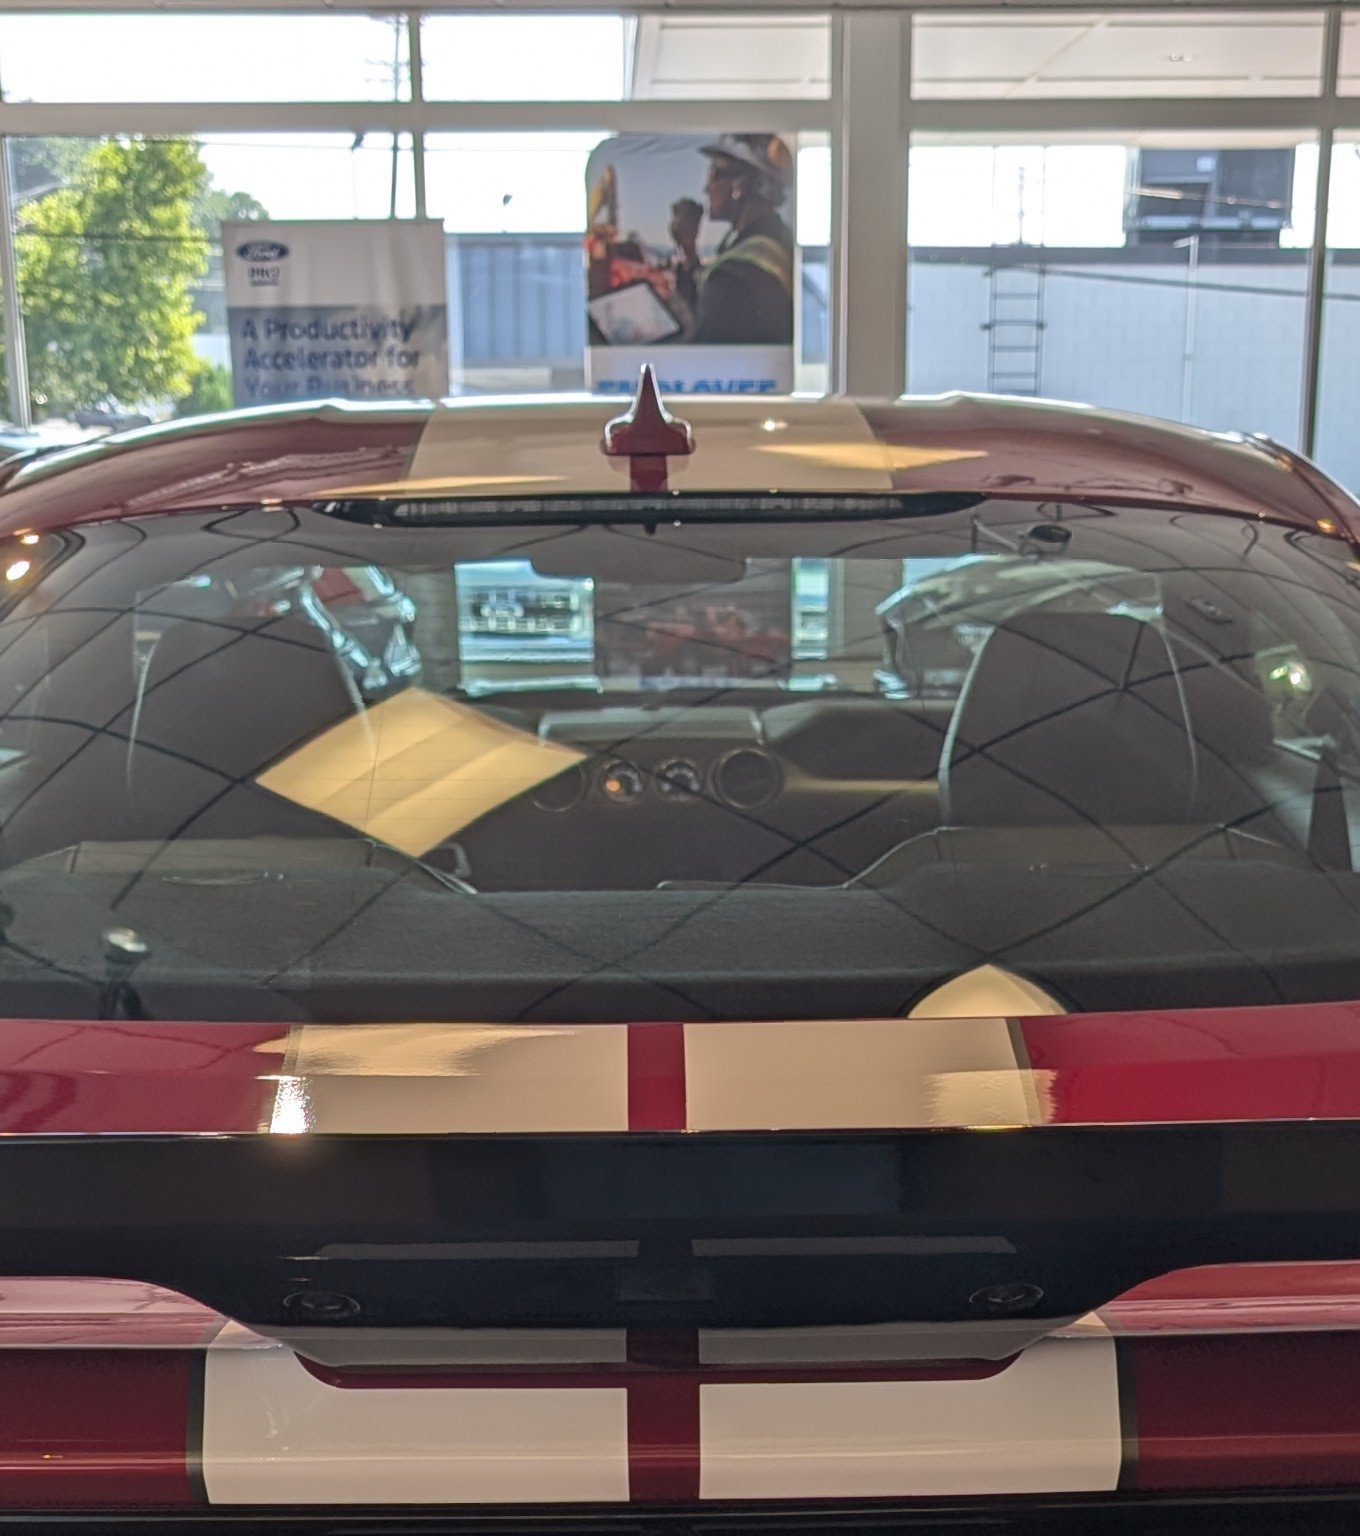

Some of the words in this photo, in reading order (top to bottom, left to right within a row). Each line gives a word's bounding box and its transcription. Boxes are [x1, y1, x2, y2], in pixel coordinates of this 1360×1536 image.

[243, 317, 258, 341] A
[264, 315, 415, 344] Productivity
[245, 348, 378, 370] Accelerator
[387, 344, 421, 369] for
[243, 378, 298, 398] Your
[307, 375, 415, 396] Business
